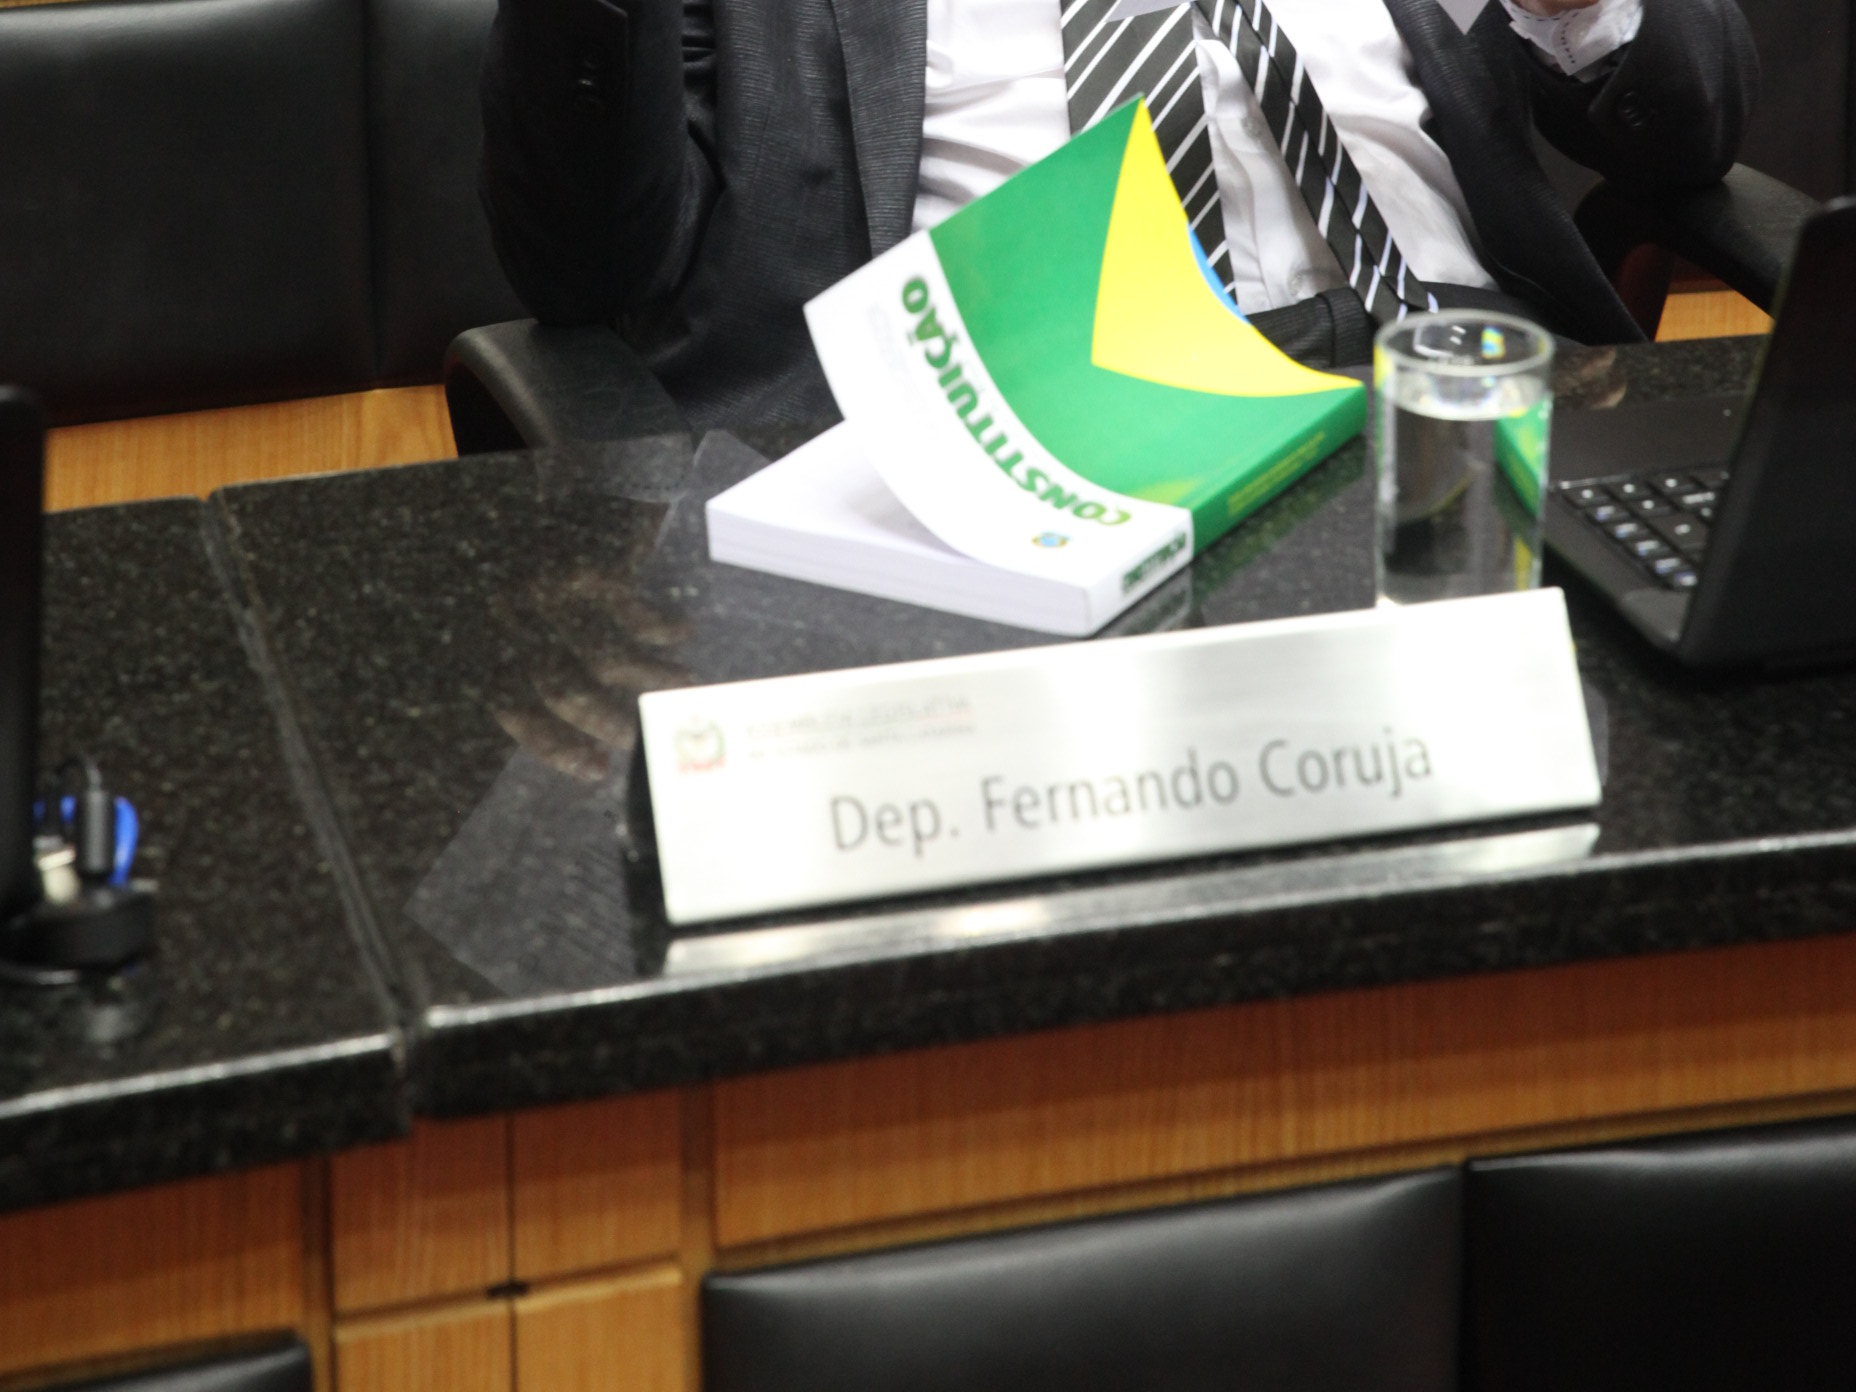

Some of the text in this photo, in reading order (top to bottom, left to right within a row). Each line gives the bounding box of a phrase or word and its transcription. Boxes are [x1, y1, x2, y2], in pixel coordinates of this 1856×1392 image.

[901, 275, 1132, 526] CONSTITUIÇÃO
[830, 726, 1433, 857] Dep. Fernando Coruja
